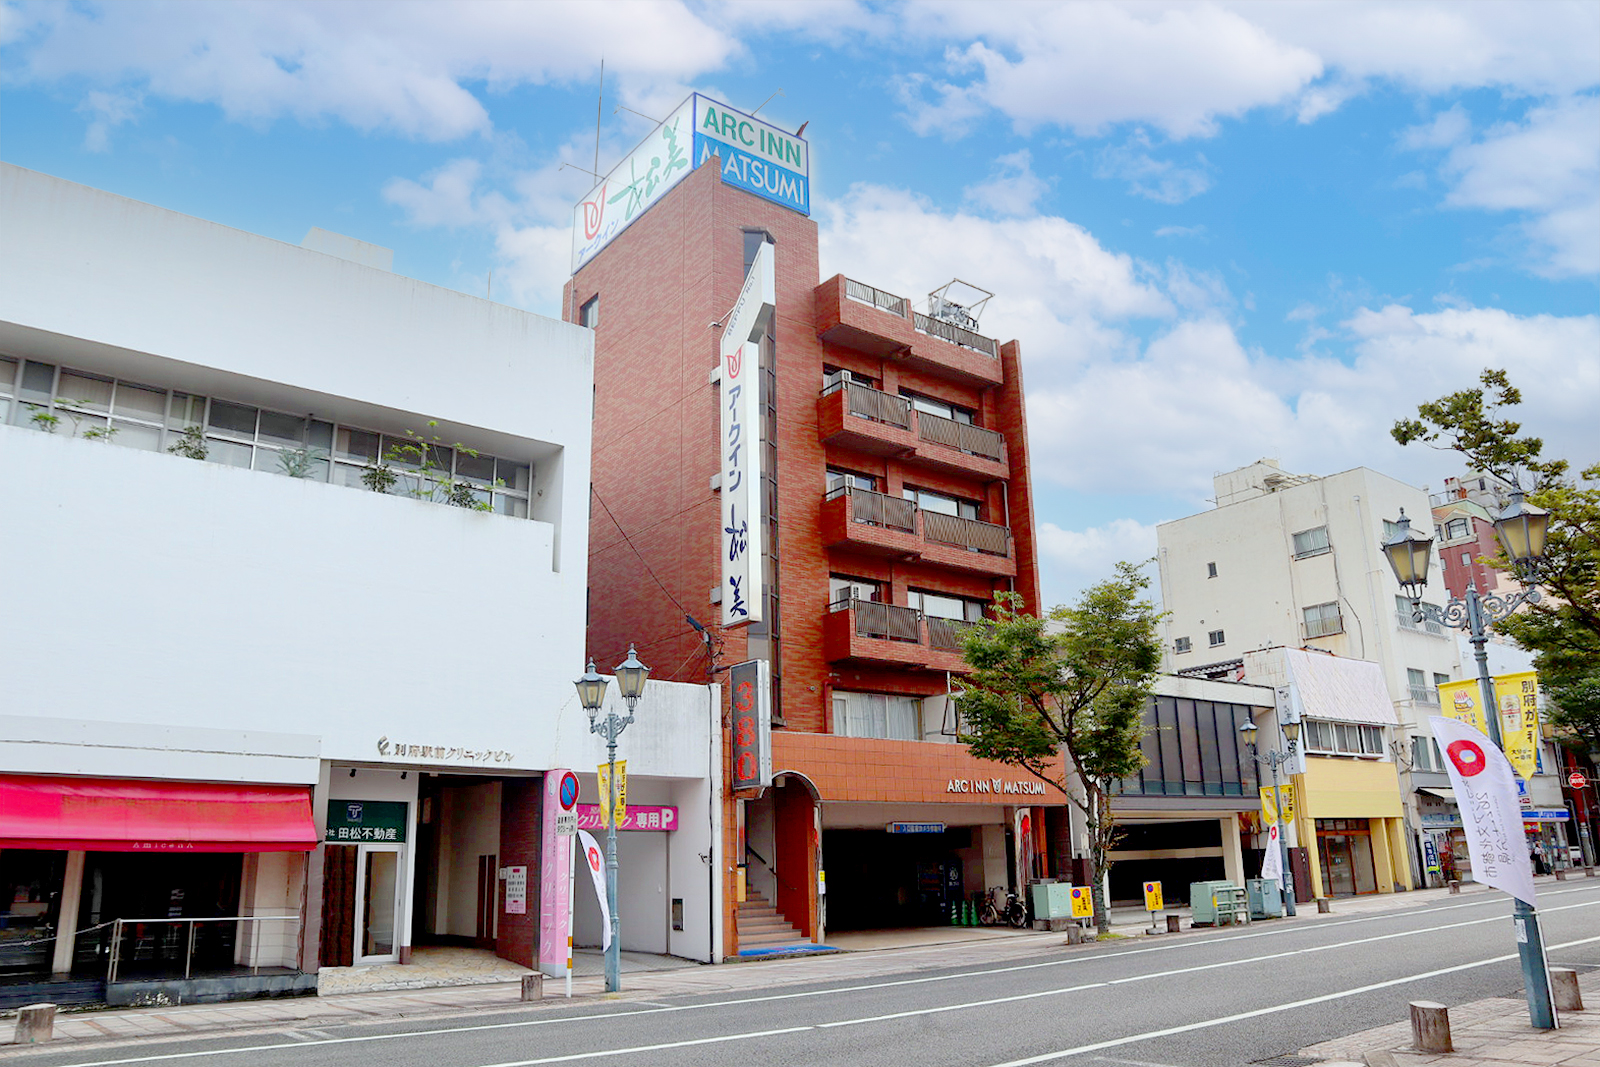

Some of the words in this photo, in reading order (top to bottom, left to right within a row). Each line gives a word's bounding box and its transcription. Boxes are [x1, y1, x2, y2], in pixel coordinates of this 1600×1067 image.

[703, 106, 755, 147] ARC
[760, 131, 801, 168] INN
[728, 384, 742, 493] アークイン
[735, 681, 757, 781] 380
[394, 743, 515, 762] 別府駅前クリニックビル
[947, 779, 968, 792] ARC
[971, 780, 990, 793] INN
[1003, 781, 1046, 795] MATSUMI
[338, 827, 397, 840] 田松不動産
